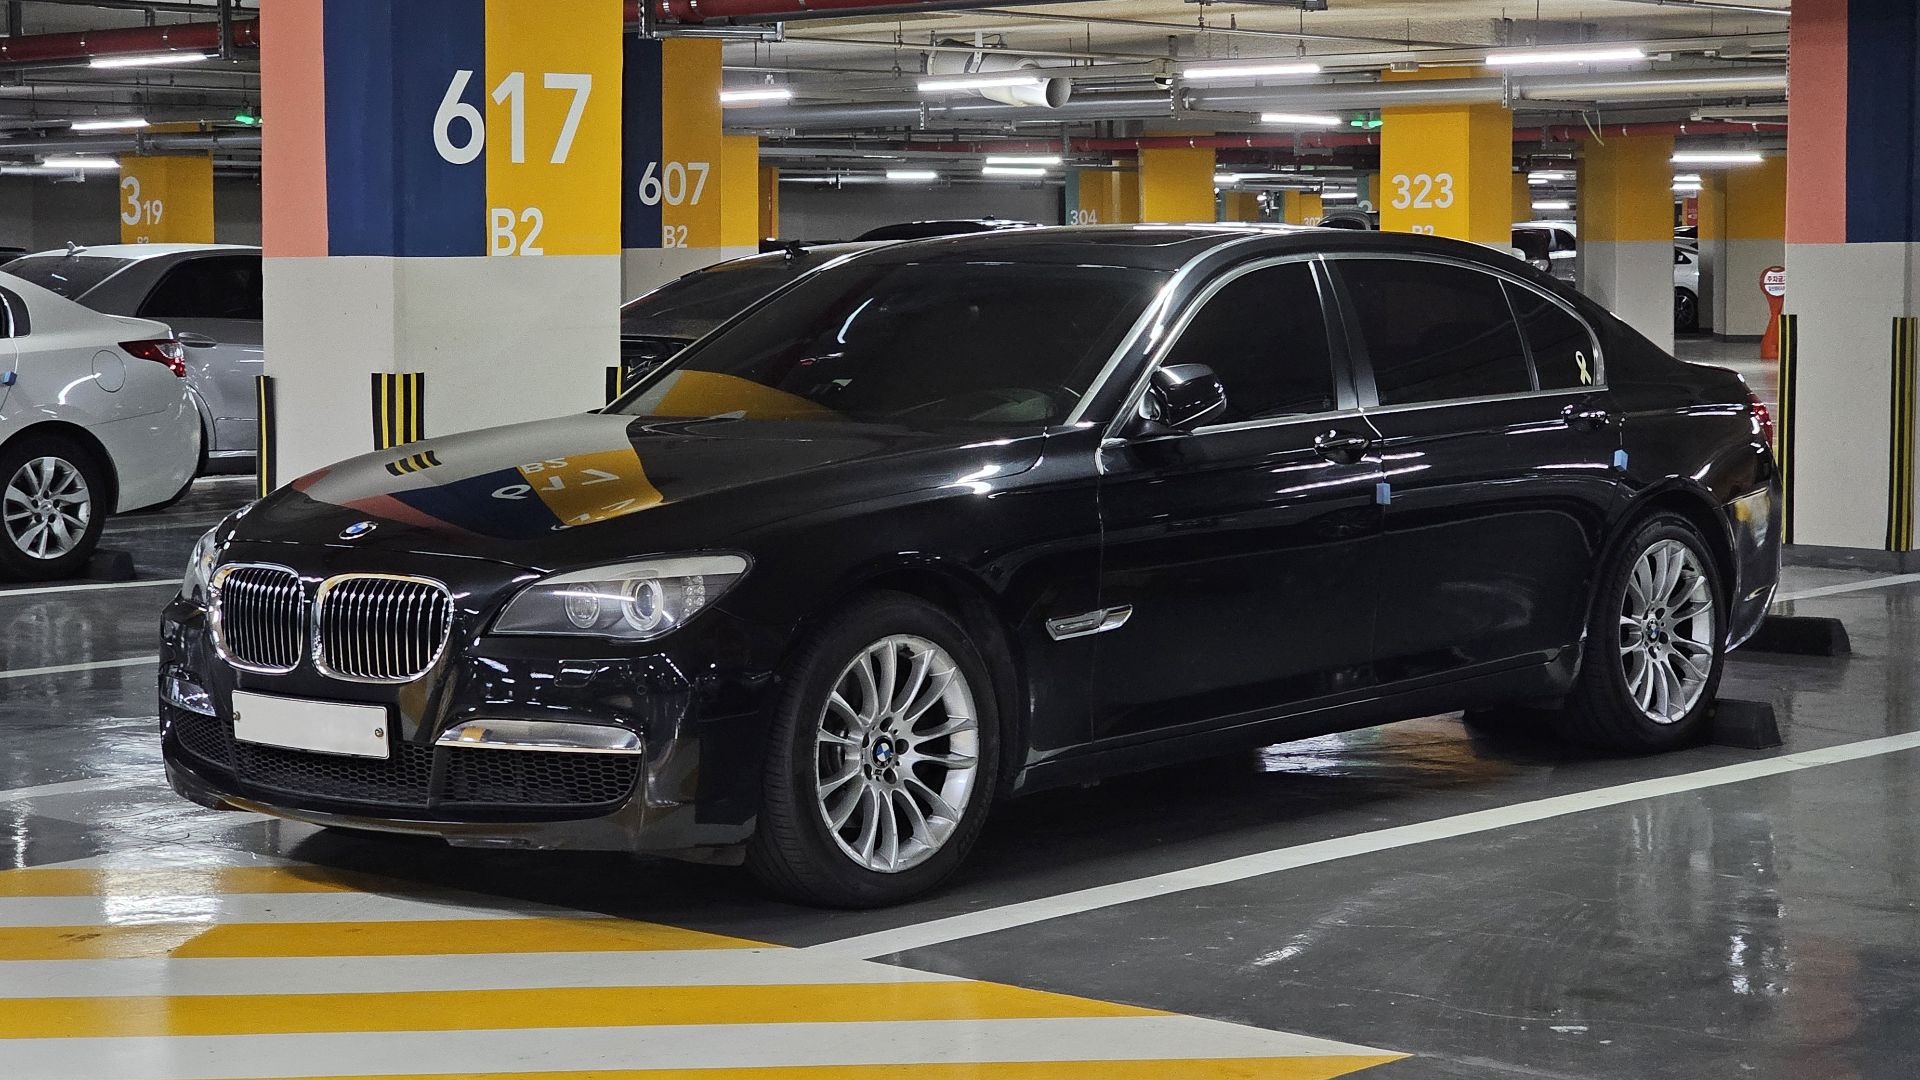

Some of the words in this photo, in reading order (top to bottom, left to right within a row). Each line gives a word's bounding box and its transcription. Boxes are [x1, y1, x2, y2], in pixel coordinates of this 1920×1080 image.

[433, 69, 592, 165] 617
[638, 161, 710, 206] 607
[1391, 173, 1454, 210] 323
[491, 207, 545, 257] B2
[663, 225, 688, 249] B2
[1070, 209, 1098, 225] 304
